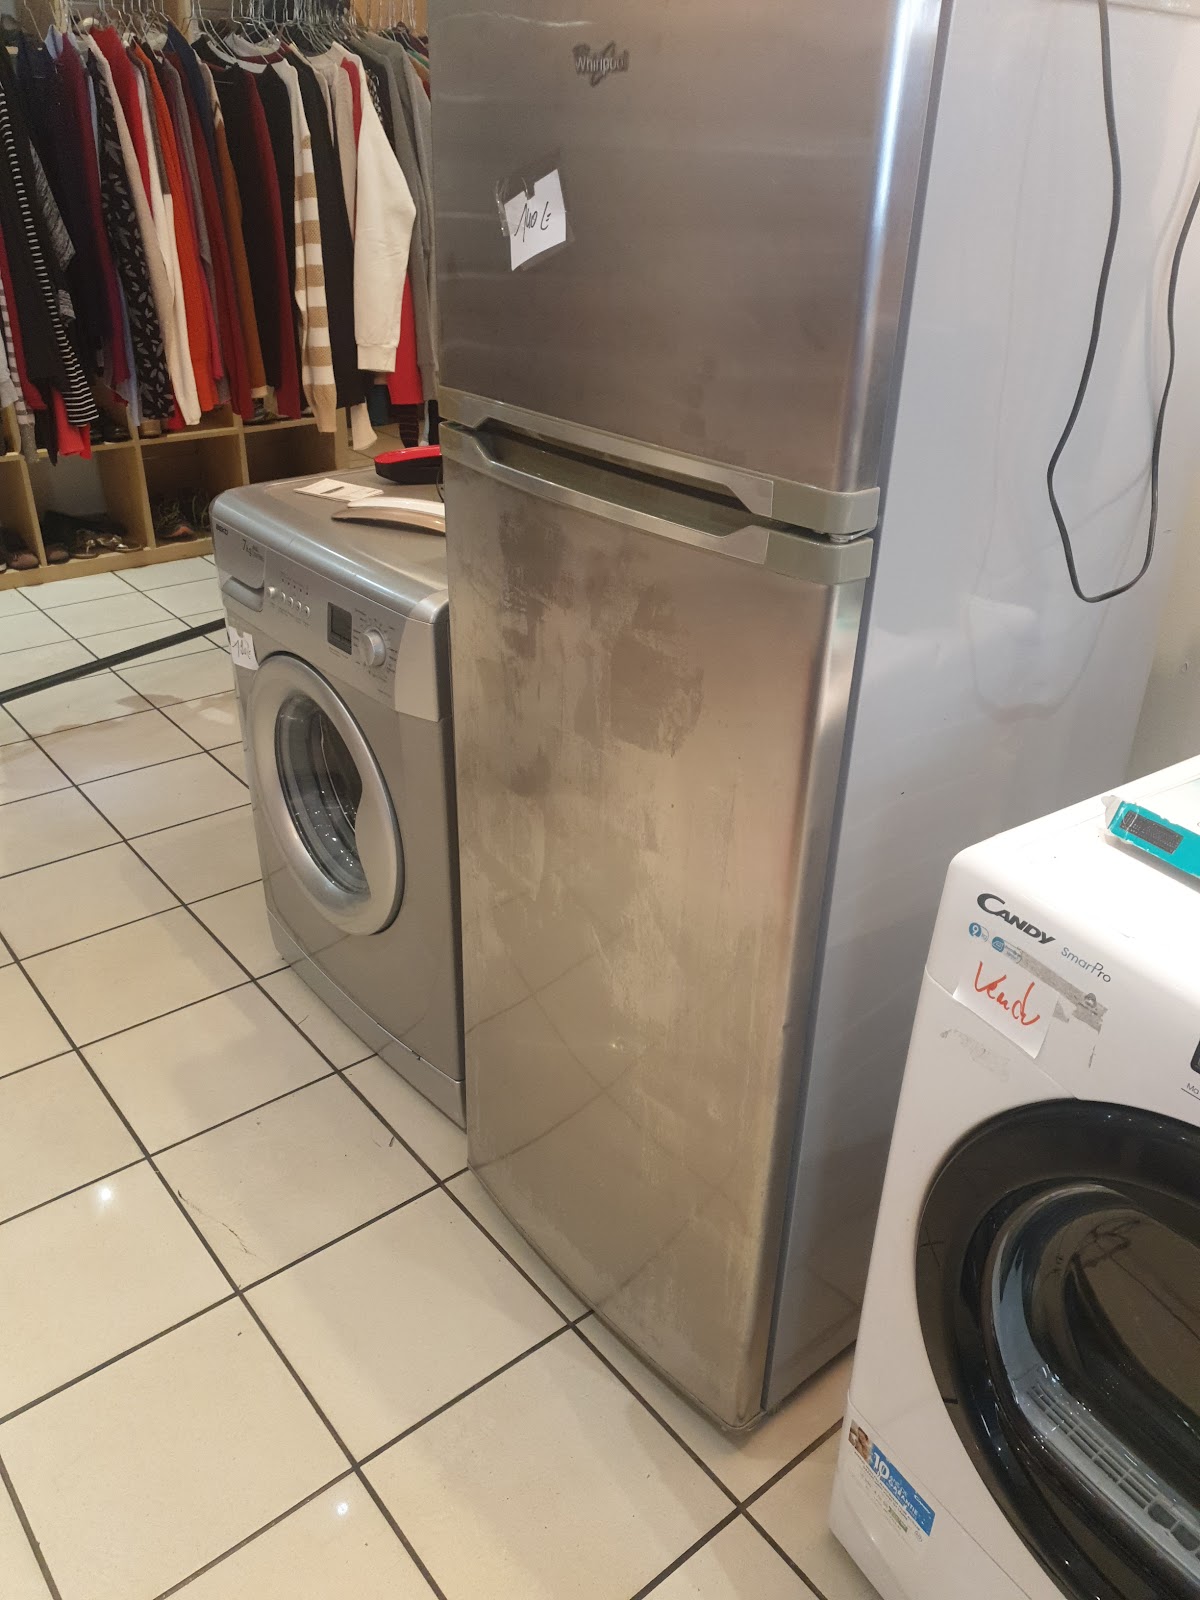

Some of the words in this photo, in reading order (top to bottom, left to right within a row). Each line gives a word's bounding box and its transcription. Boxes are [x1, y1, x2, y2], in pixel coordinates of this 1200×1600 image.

[573, 51, 630, 77] Whirlpool
[977, 893, 1056, 944] CANDY
[873, 1453, 890, 1480] 10
